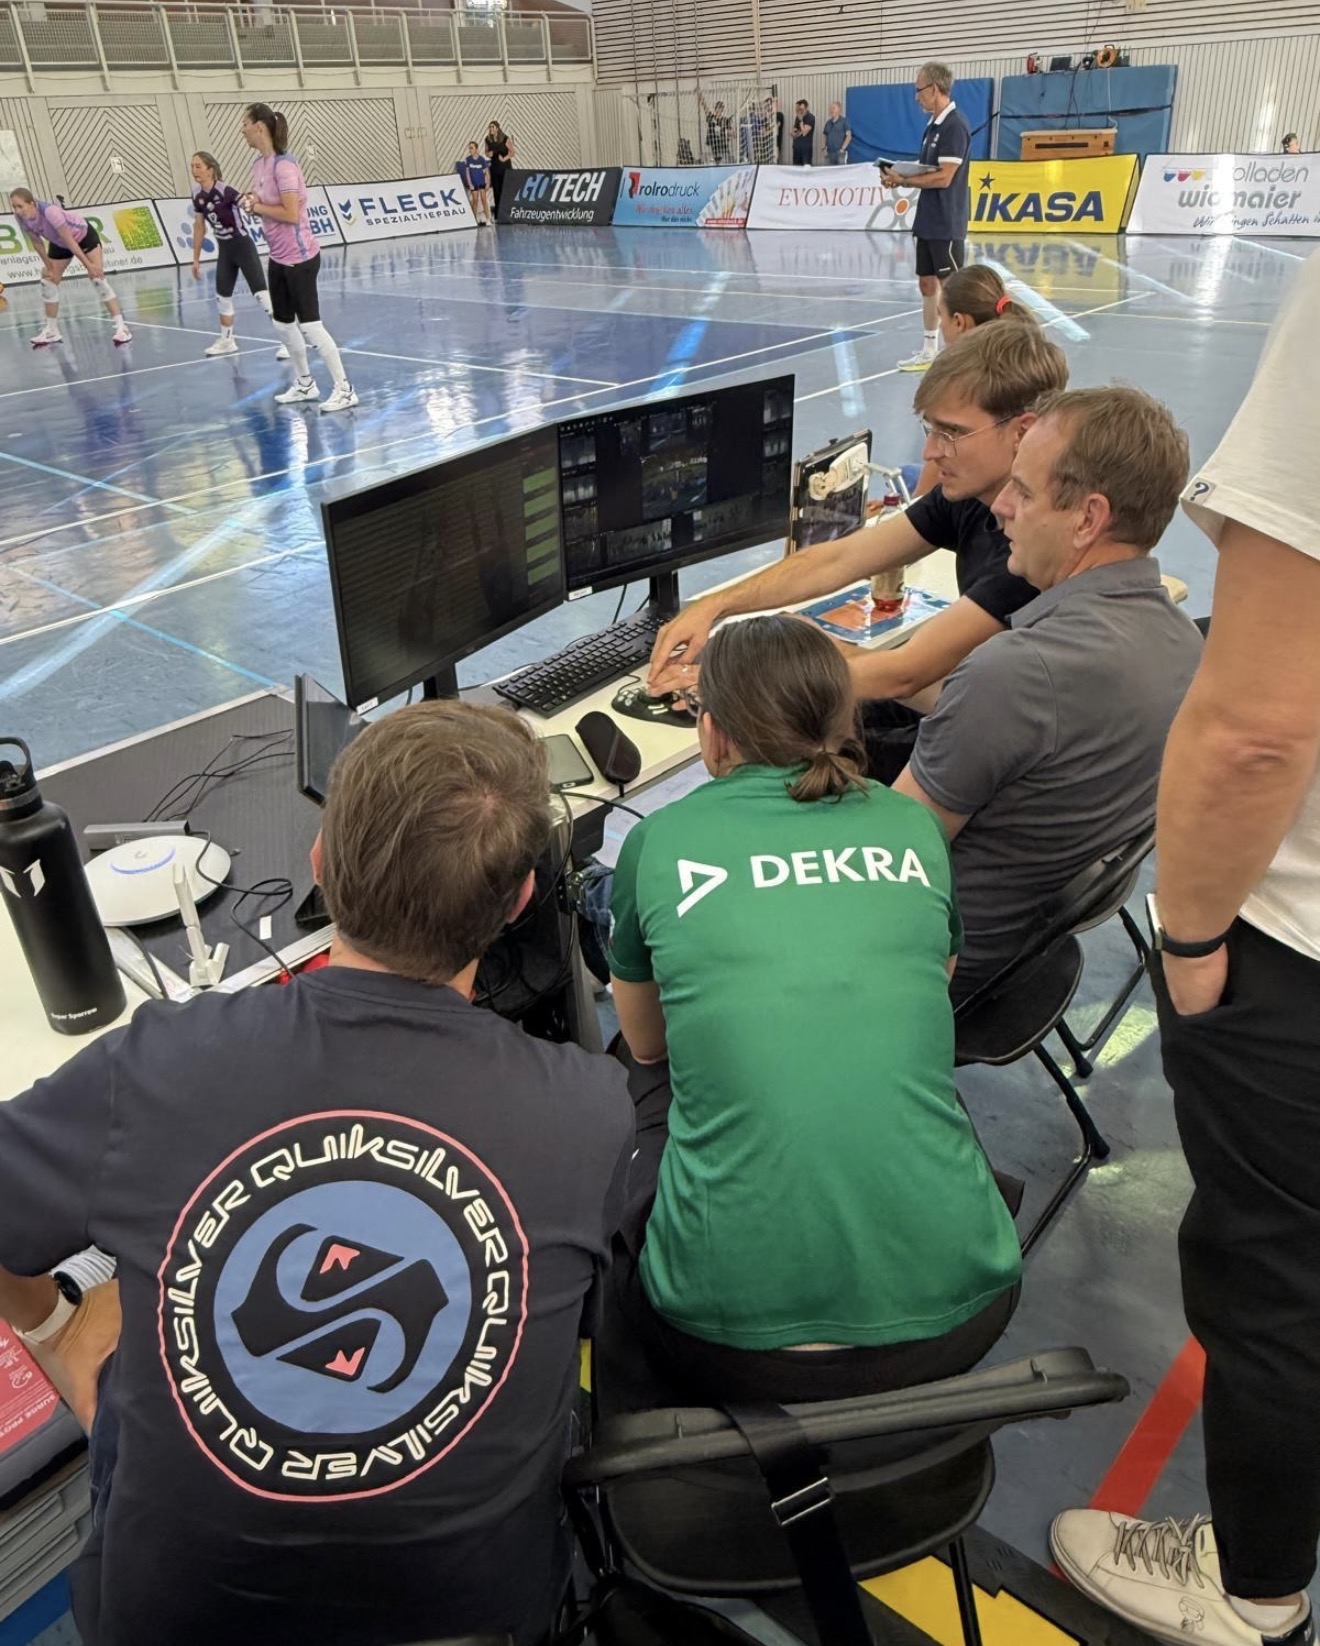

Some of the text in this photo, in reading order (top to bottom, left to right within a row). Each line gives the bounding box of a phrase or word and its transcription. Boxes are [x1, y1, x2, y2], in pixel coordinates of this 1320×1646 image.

[1231, 161, 1309, 183] olladen
[639, 181, 701, 197] rolrodruck
[358, 188, 462, 216] FLECK
[968, 186, 1104, 222] IKASA
[366, 207, 467, 226] SPEZIALTIEFBAU
[510, 206, 595, 222] Fahrzeugentwicklung
[1262, 211, 1309, 229] Schatten
[750, 847, 931, 889] DEKRA
[167, 1123, 510, 1480] QUIKSILVER QUIKSILVER QUIKSILVER
